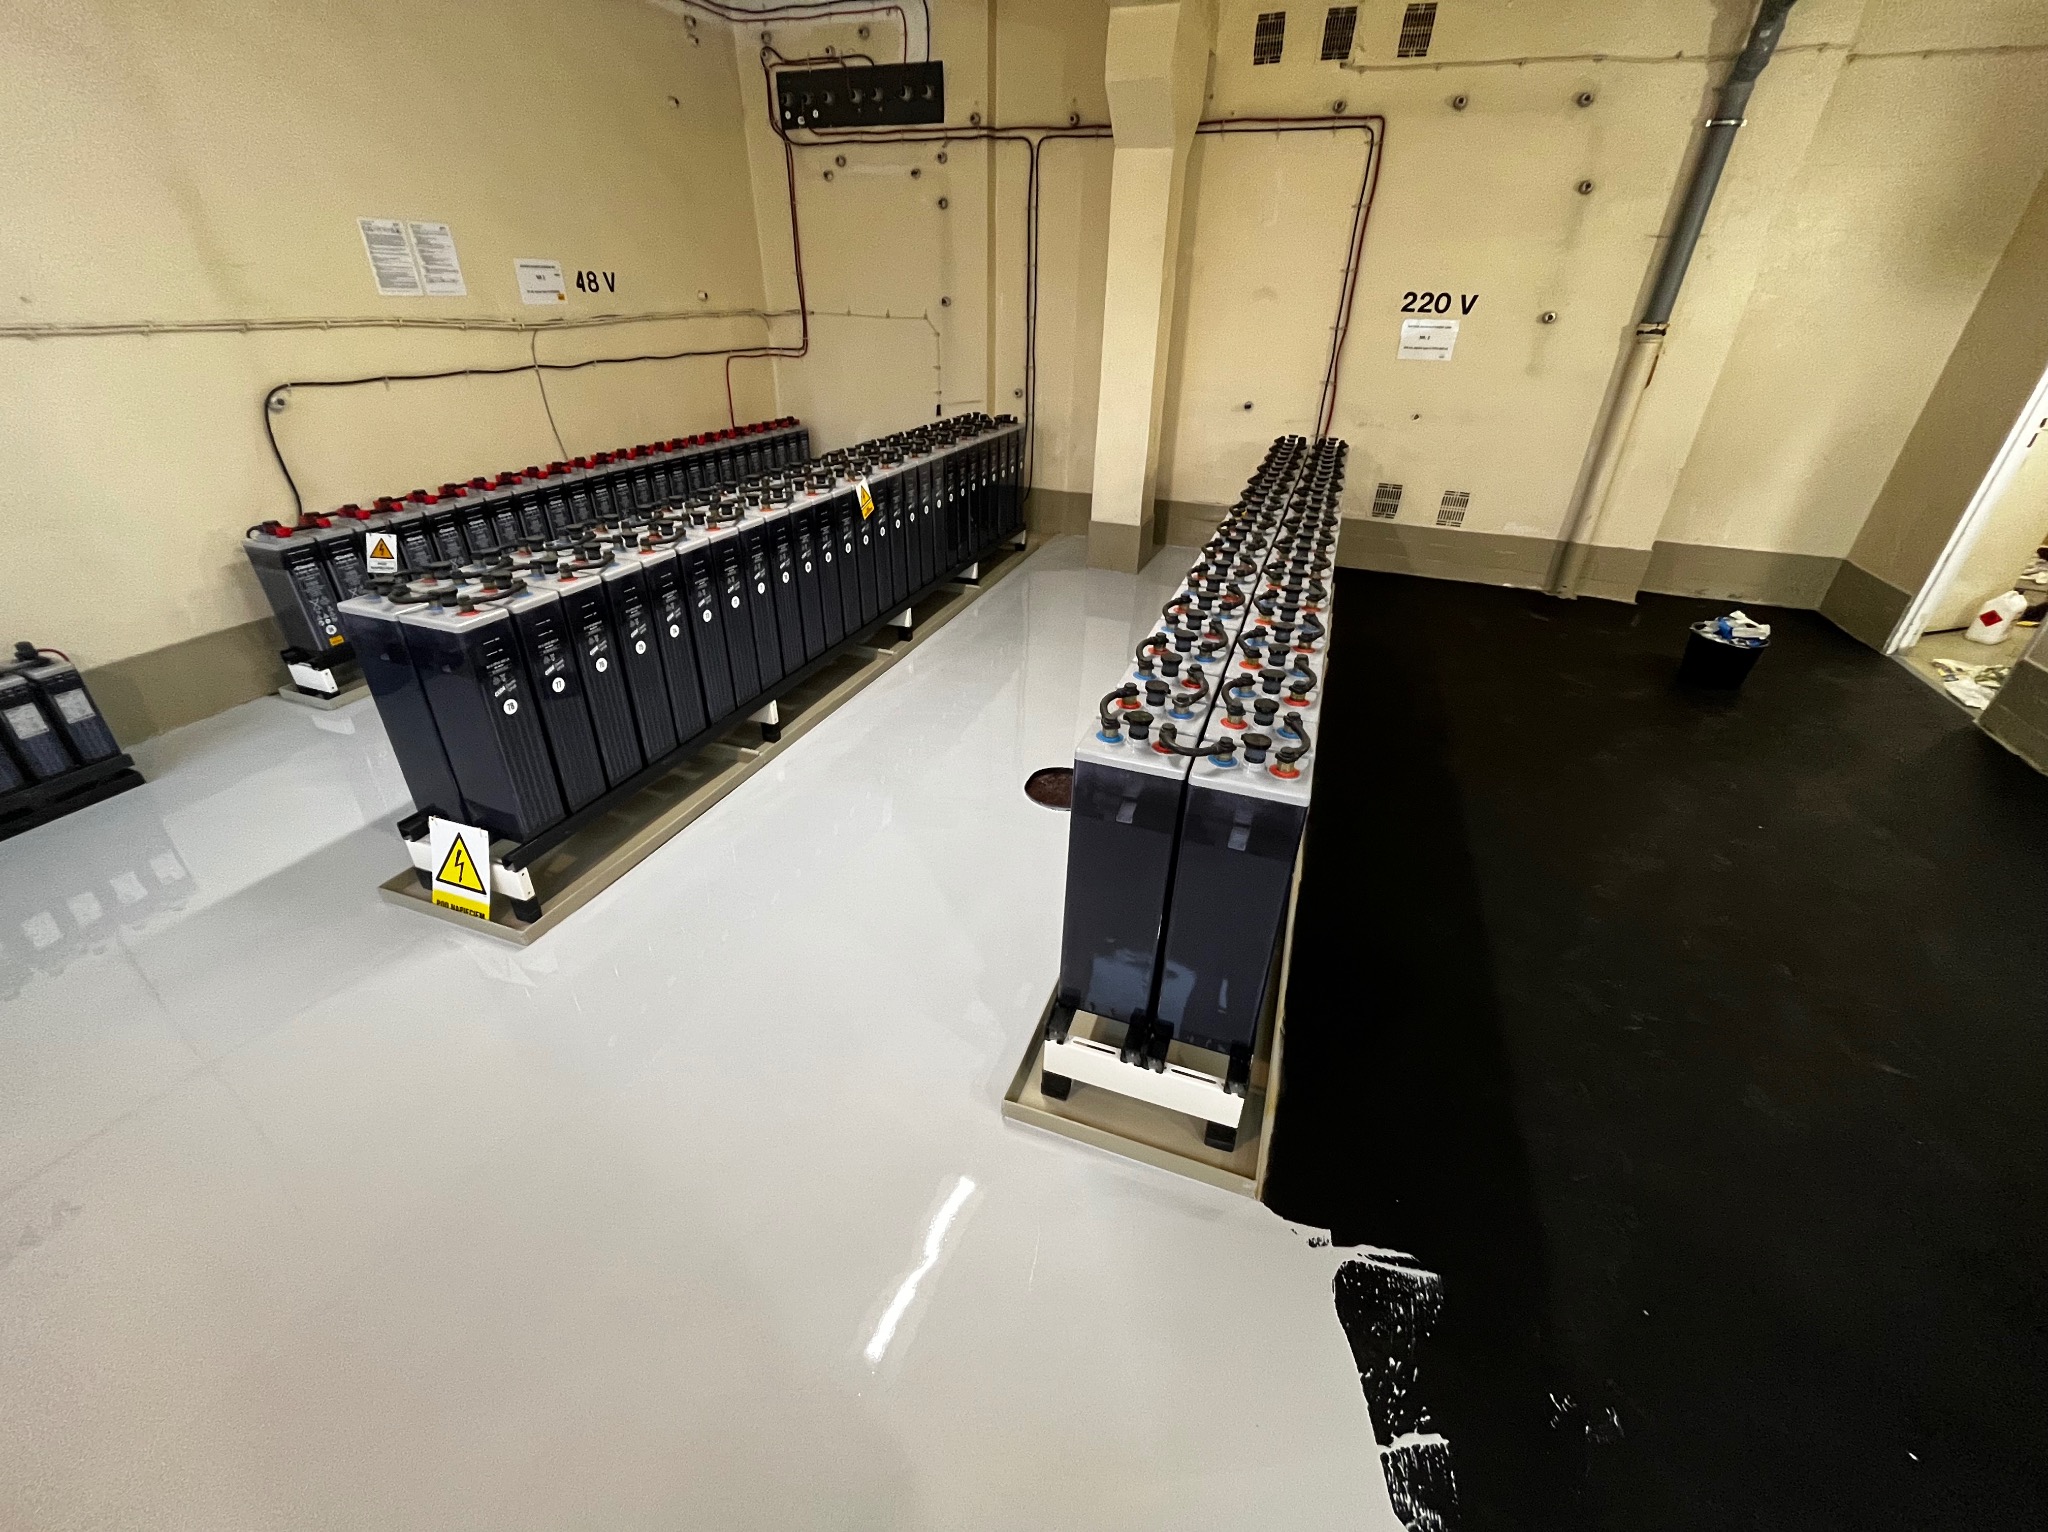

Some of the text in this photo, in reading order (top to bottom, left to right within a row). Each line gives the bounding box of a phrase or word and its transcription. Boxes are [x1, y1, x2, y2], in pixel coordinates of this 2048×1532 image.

[576, 270, 615, 293] 48 V
[1400, 291, 1479, 315] 220 V
